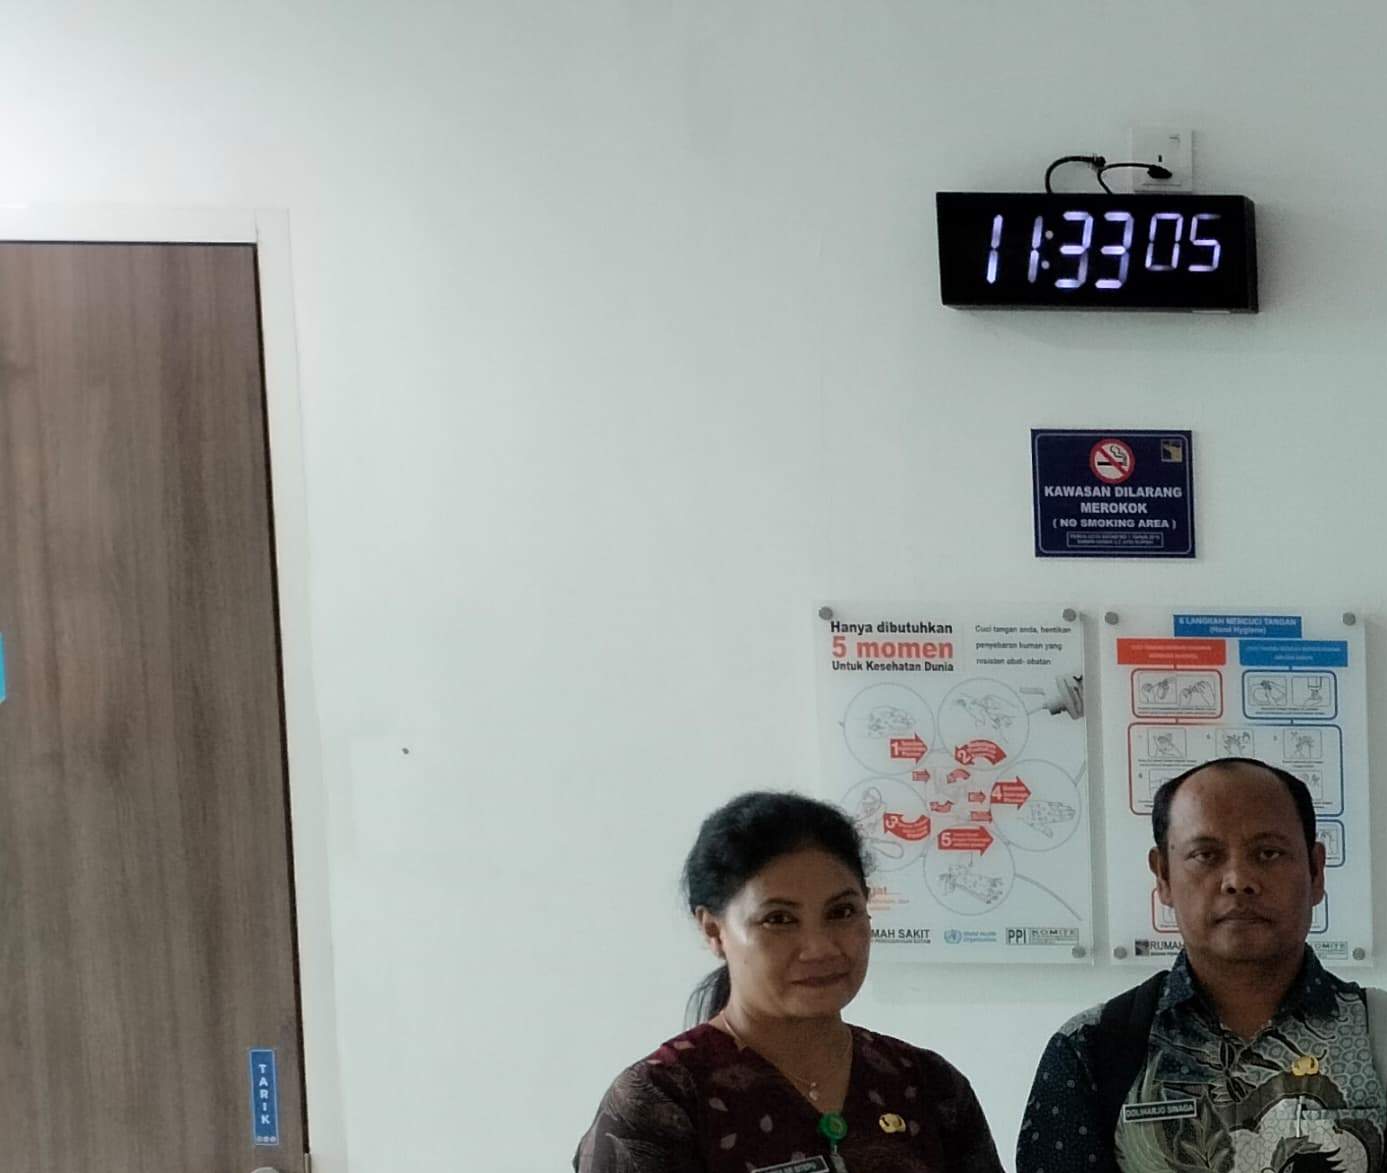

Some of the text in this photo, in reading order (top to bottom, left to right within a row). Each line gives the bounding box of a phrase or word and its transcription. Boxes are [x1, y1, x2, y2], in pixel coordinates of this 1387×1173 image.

[1044, 486, 1183, 498] KAWASAN DILARANG
[1080, 502, 1148, 513] MEROKOK
[1060, 518, 1078, 528] NO
[1080, 519, 1136, 528] SMOKING
[1138, 519, 1170, 528] AREA
[830, 621, 953, 636] Hanya dibutuhkan
[832, 635, 954, 659] 5 momen
[832, 661, 954, 672] Untuk Kesehatan Dunia
[871, 929, 931, 939] MAH SAKIT
[1008, 929, 1026, 945] PPI
[258, 1063, 271, 1125] TARIK
